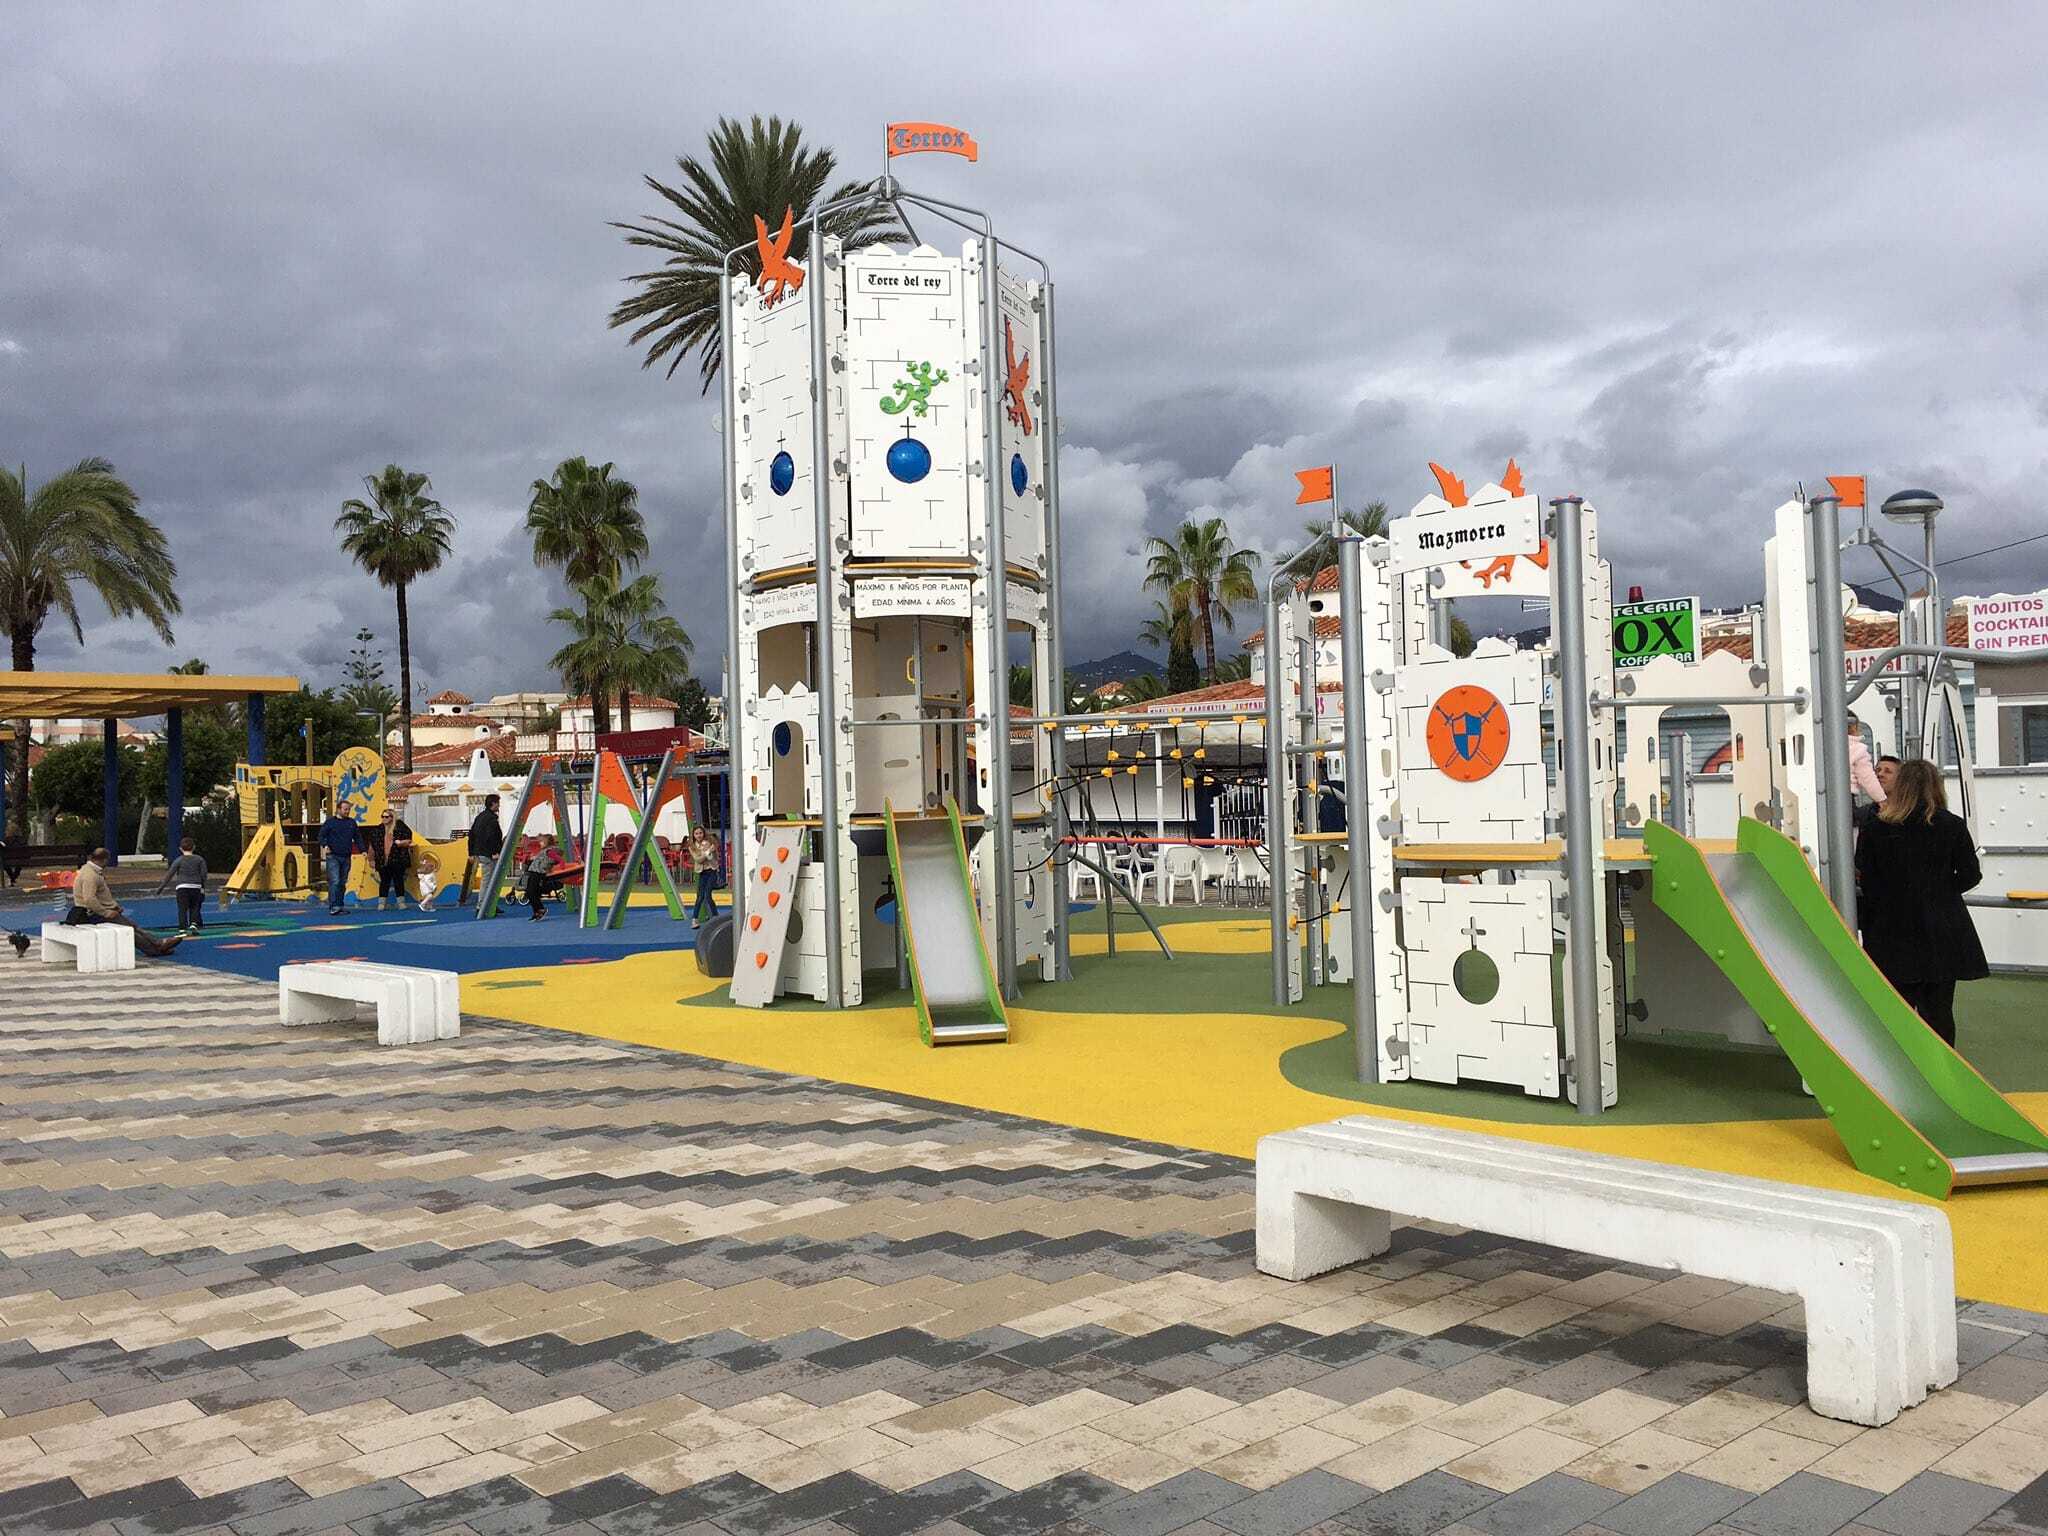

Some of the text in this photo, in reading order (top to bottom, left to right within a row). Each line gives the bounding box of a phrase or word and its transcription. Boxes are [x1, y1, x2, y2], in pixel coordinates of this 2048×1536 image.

[893, 128, 967, 149] Torrox
[868, 273, 942, 290] Torre del rey
[1418, 523, 1506, 550] Mazmorra
[898, 581, 920, 591] NIÑOS
[922, 583, 938, 591] POR
[940, 583, 969, 591] PLANTA
[871, 598, 893, 607] EDAD
[925, 598, 931, 606] 4
[935, 596, 956, 606] AÑOS
[1974, 598, 2044, 616] MOJITOS
[1974, 615, 2048, 633] COCKTAI
[1974, 636, 2003, 650] GIN
